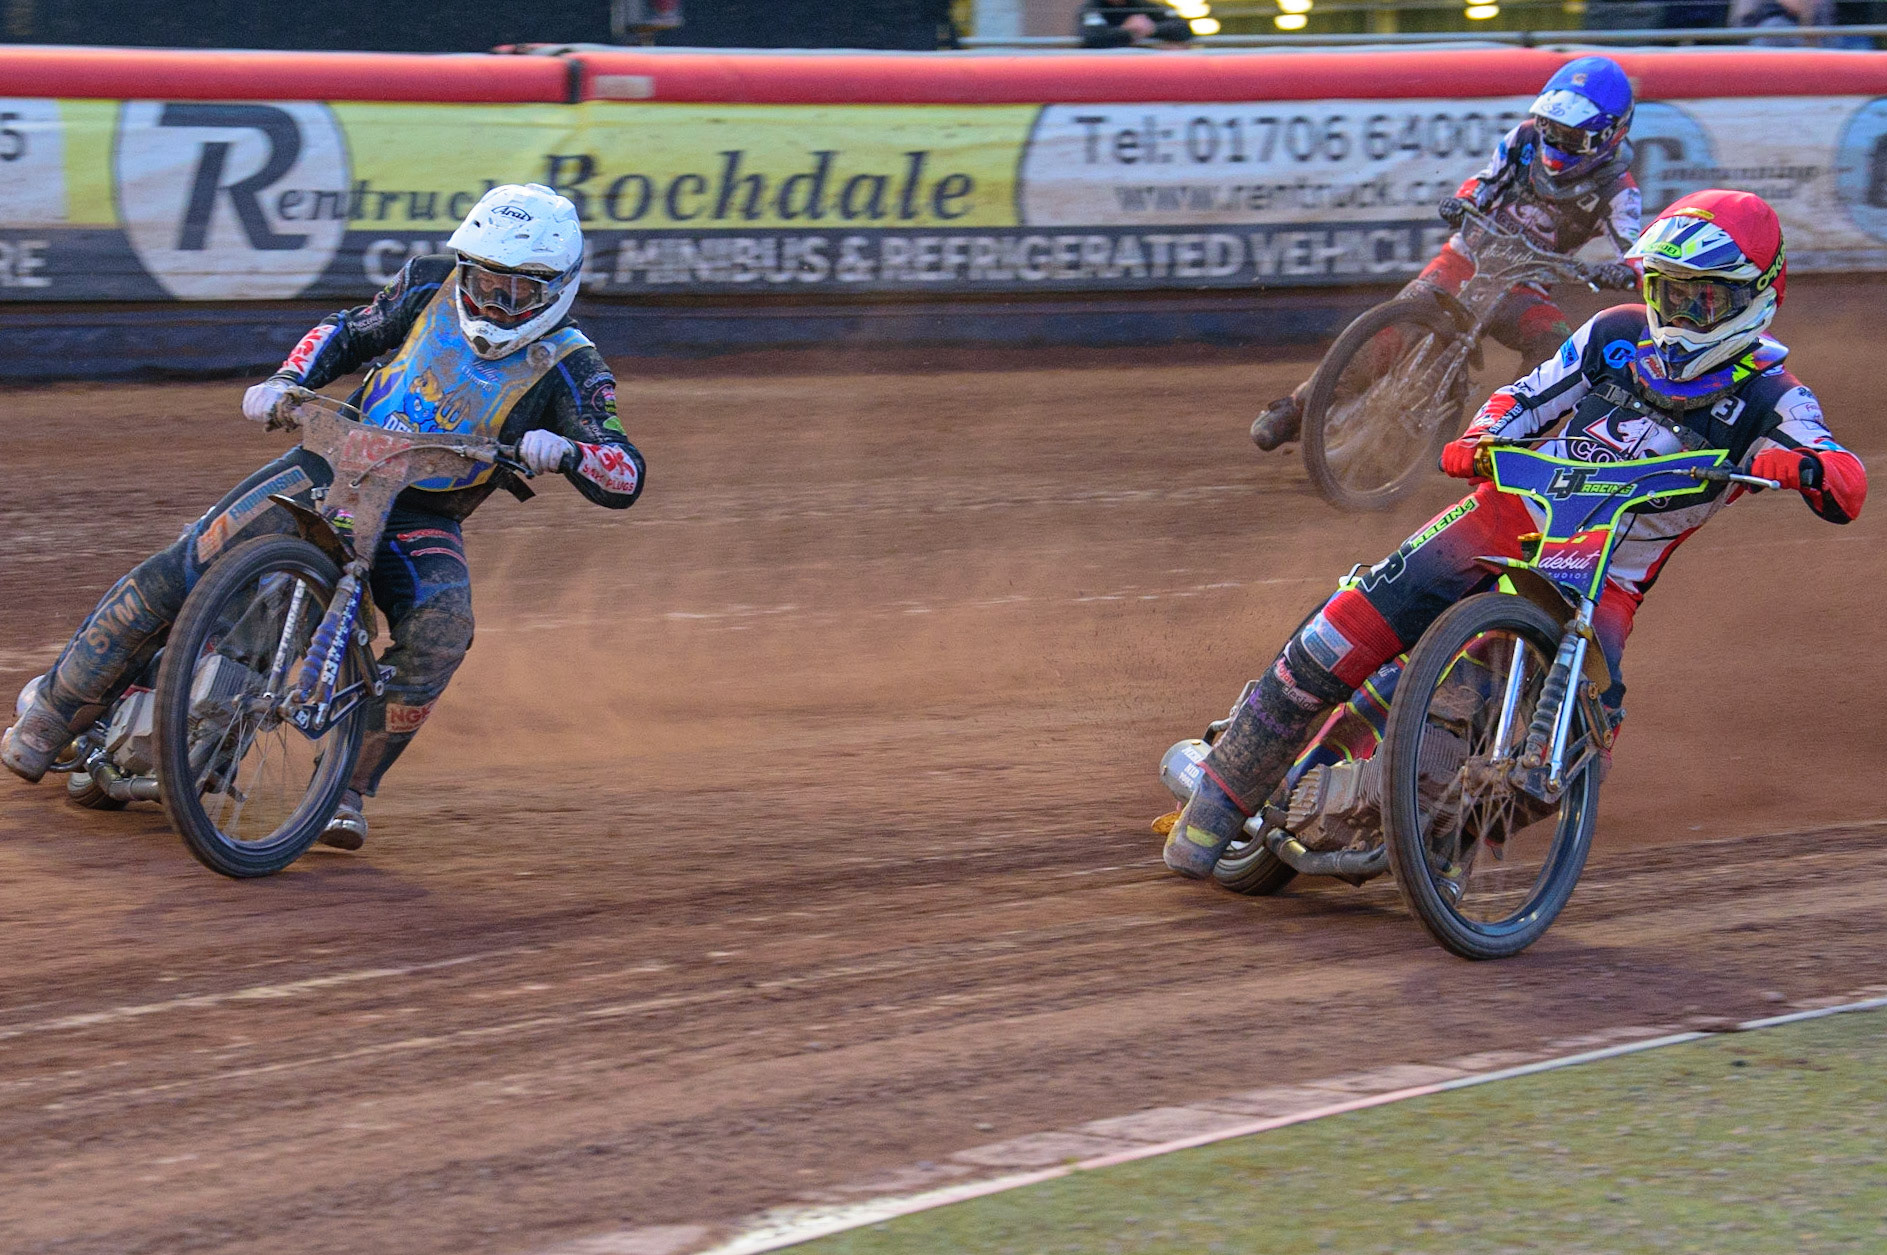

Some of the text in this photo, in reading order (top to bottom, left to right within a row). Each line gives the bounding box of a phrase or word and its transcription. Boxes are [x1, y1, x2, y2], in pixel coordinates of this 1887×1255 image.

[1073, 115, 1174, 164] Tel:
[1187, 116, 1351, 163] 01706
[544, 150, 973, 222] Rochdale
[614, 236, 831, 283] MINIBUS
[835, 236, 876, 283] &
[880, 231, 1246, 282] REFRIGERATED
[1714, 399, 1740, 421] 3
[1581, 483, 1633, 495] RACING
[1538, 549, 1601, 570] debut
[86, 592, 141, 654] SYM
